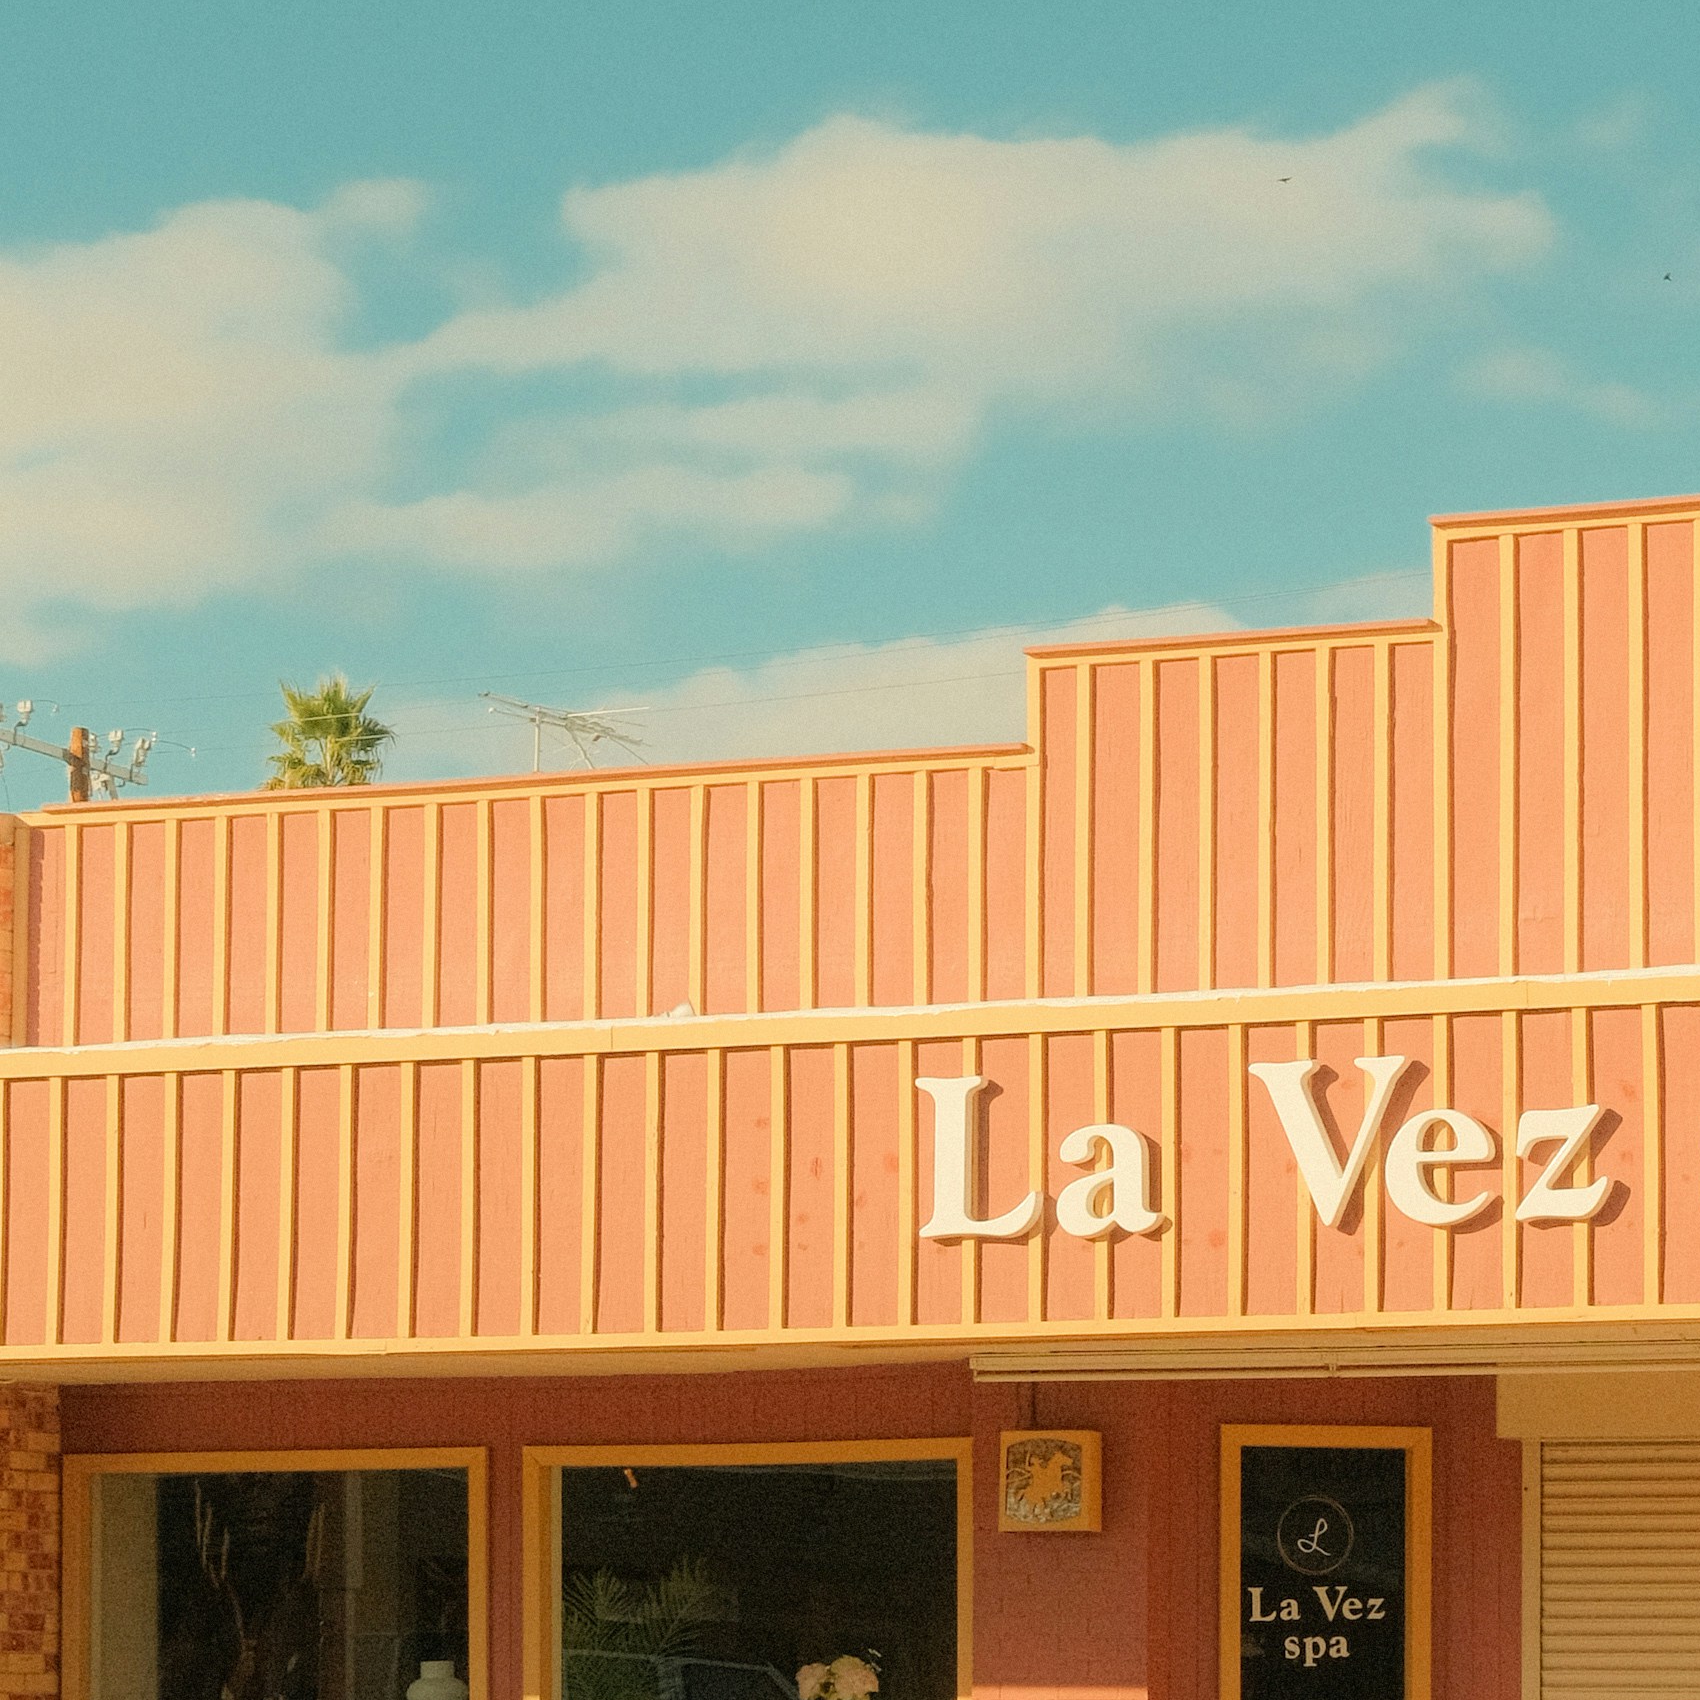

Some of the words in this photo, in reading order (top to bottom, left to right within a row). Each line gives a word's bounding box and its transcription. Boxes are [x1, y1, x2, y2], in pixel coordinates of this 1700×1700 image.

[915, 1074, 1168, 1241] La
[1248, 1055, 1617, 1229] Vez
[1247, 1586, 1301, 1622] La
[1313, 1586, 1386, 1622] Vez
[1284, 1635, 1350, 1668] spa
